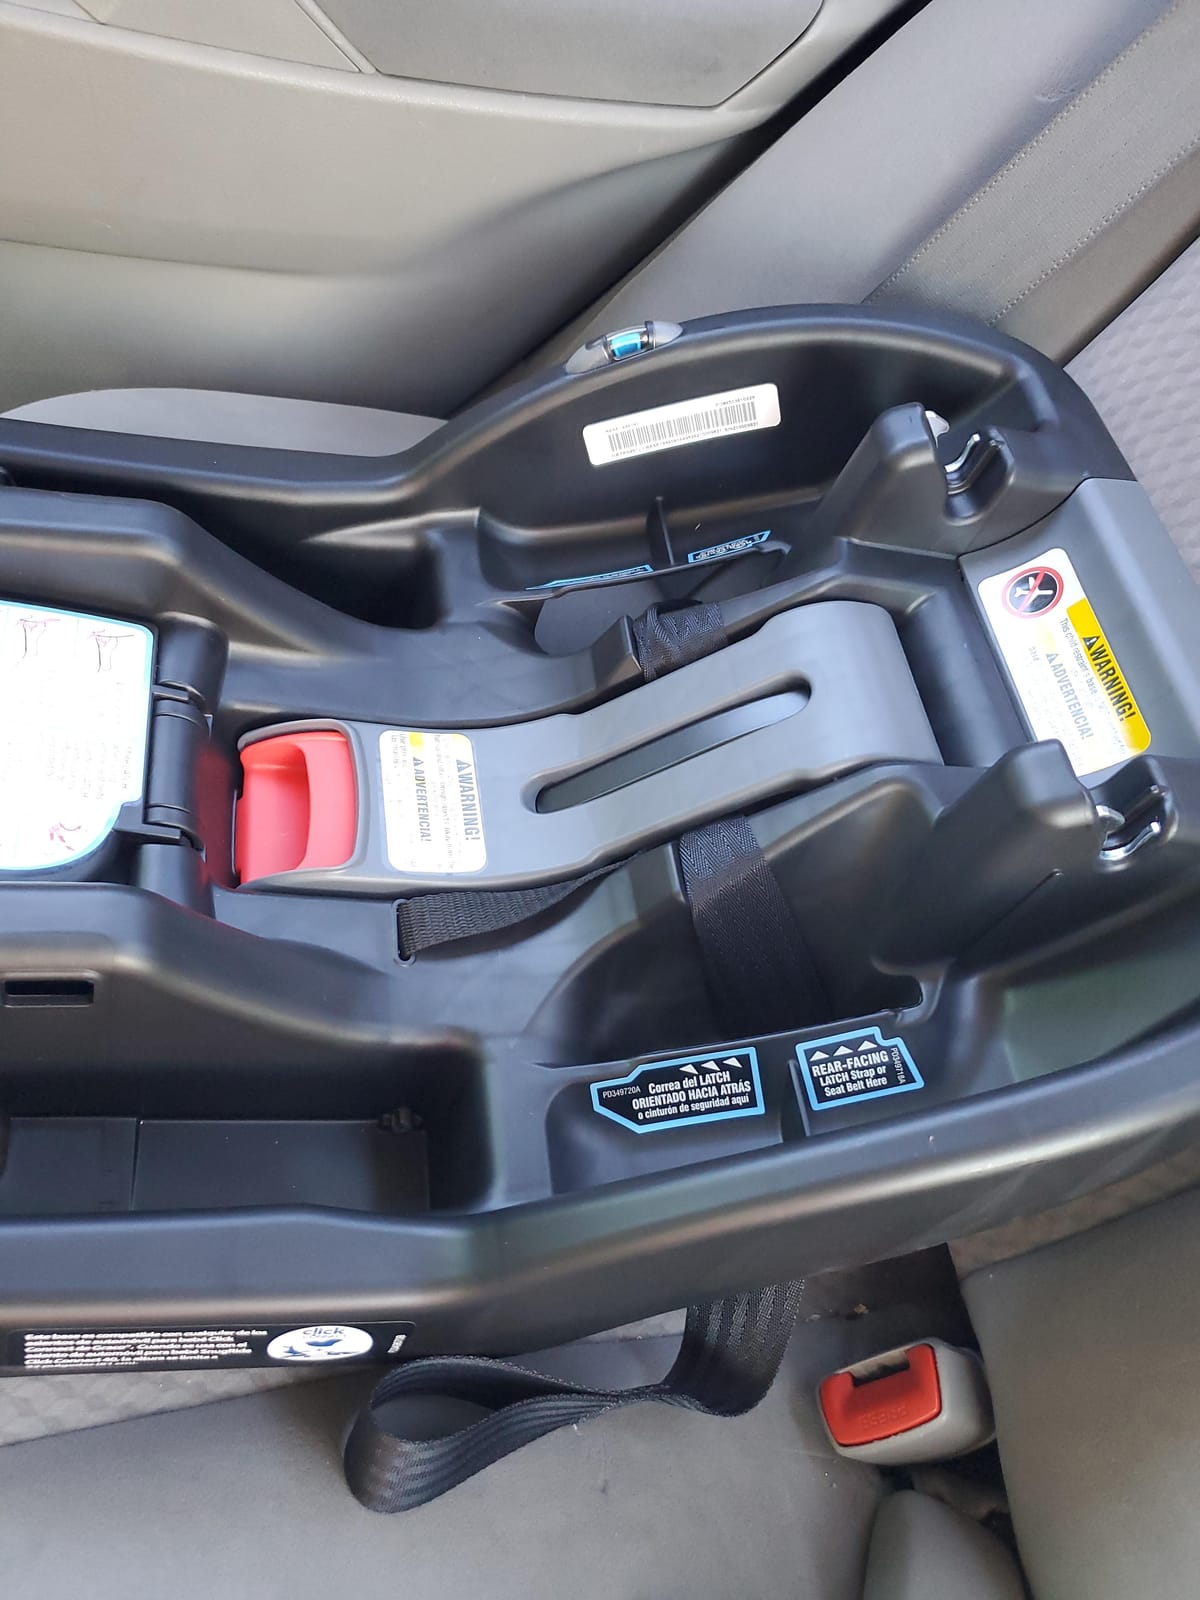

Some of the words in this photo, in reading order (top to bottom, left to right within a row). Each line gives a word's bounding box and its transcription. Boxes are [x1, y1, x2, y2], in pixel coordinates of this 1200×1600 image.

[1060, 618, 1070, 632] This
[1090, 644, 1137, 722] WARNING!
[1051, 663, 1095, 740] ADVERTENCIA!
[414, 768, 432, 842] ADVERTENCIA!
[457, 772, 481, 840] WARNING!
[811, 1050, 889, 1077] REAR-FACING
[819, 1072, 849, 1086] LATCH
[850, 1069, 875, 1080] Strap
[876, 1066, 887, 1074] or
[602, 1085, 641, 1099] PD349720A
[632, 1090, 687, 1110] ORIENTADO
[688, 1085, 718, 1101] HACIA
[720, 1079, 751, 1095] ATRÁS
[648, 1080, 681, 1095] Correa
[682, 1075, 698, 1088] del
[699, 1070, 731, 1085] LATCH
[824, 1084, 846, 1097] Seat
[847, 1081, 865, 1092] Belt
[866, 1076, 888, 1089] Here
[637, 1112, 644, 1120] o
[644, 1104, 678, 1119] cinturón
[679, 1103, 690, 1113] de
[690, 1097, 730, 1112] seguridad
[731, 1092, 750, 1106] aquí
[303, 1327, 345, 1337] click
